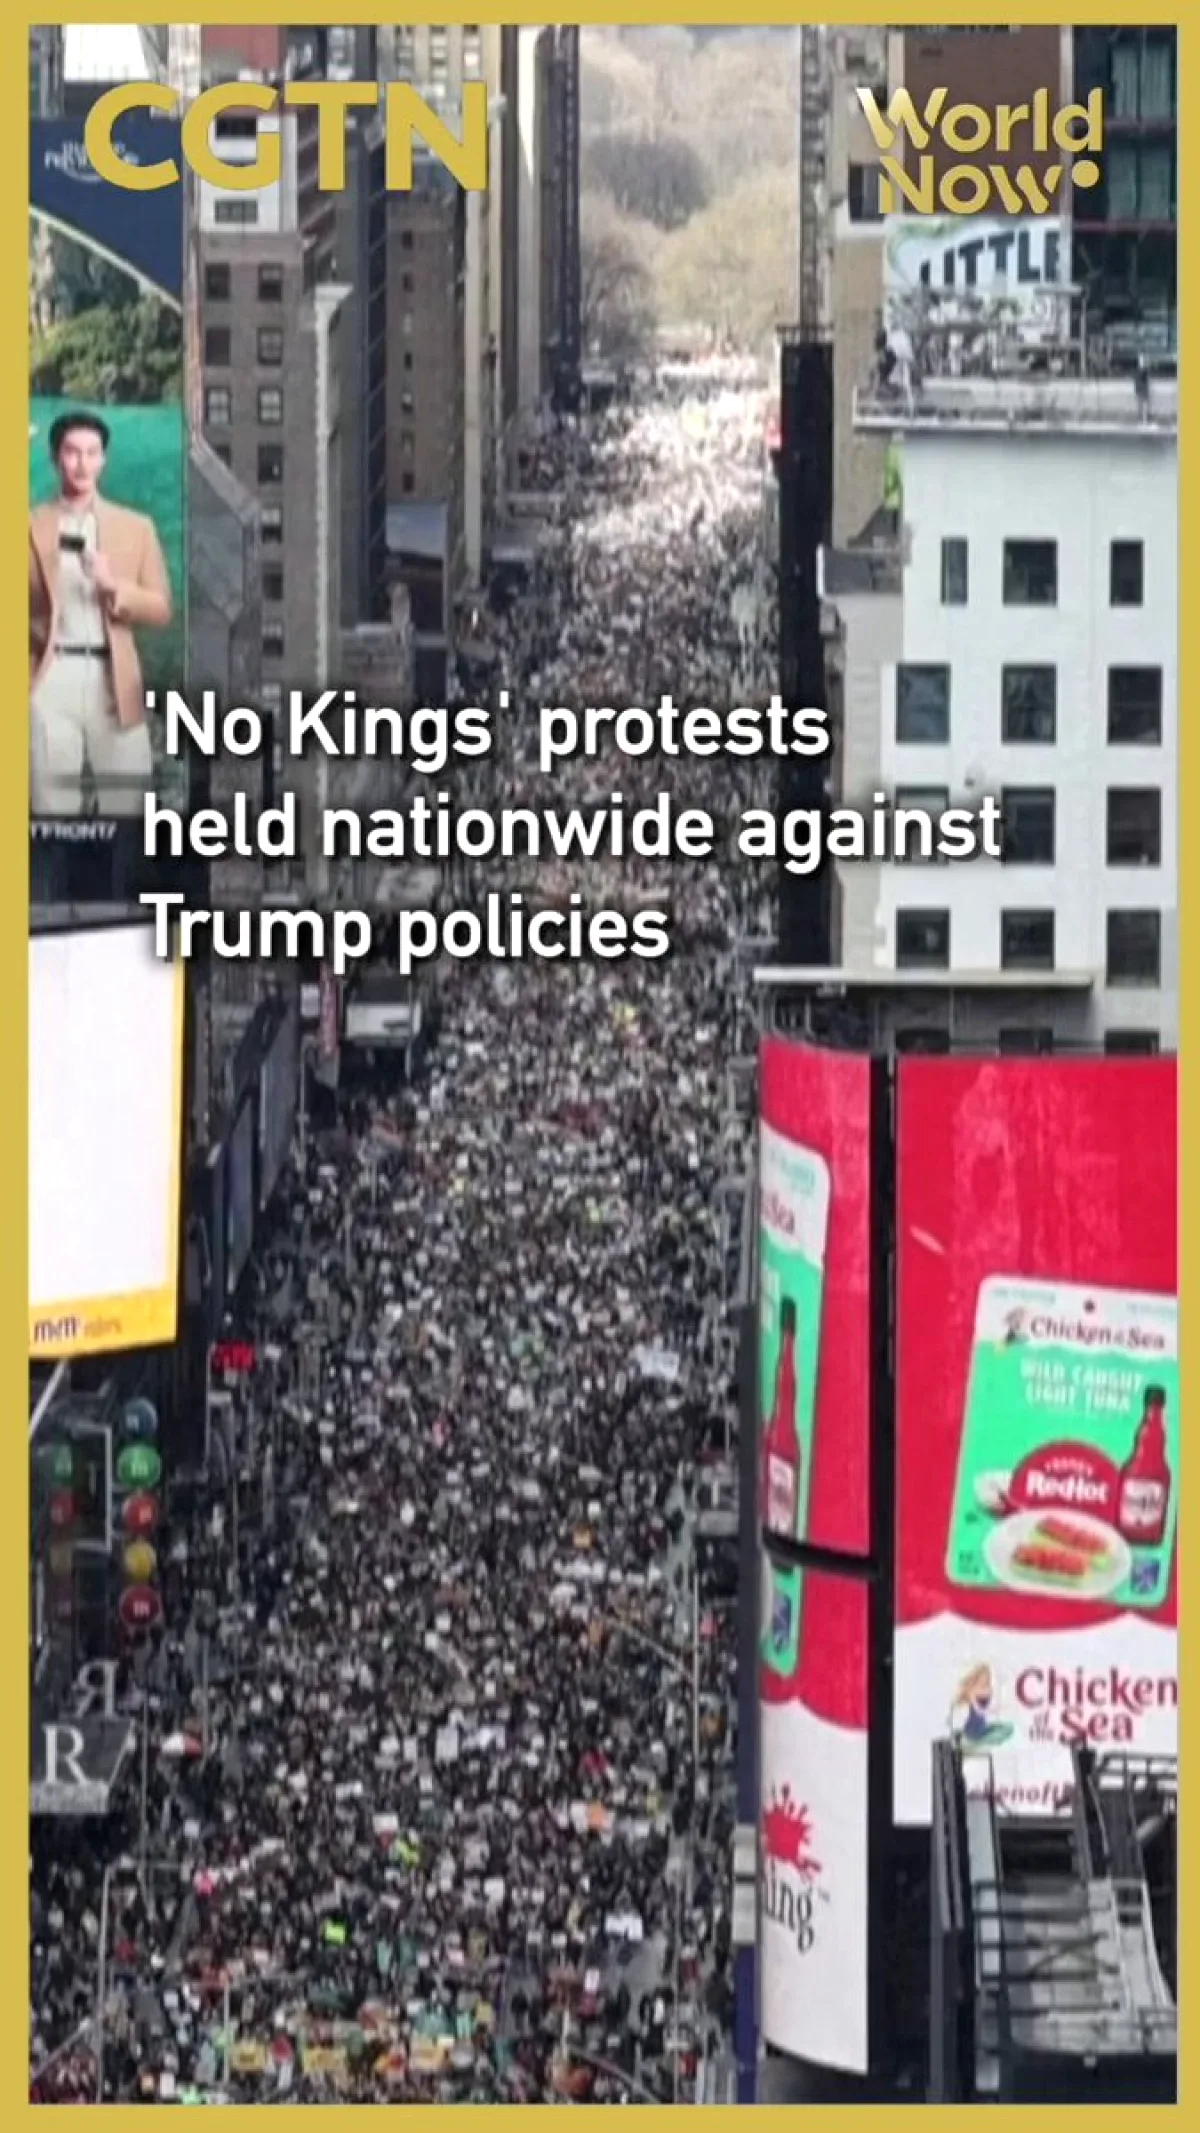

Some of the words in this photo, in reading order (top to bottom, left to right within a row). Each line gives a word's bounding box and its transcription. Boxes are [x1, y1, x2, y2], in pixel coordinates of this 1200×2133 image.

[1030, 1314, 1112, 1346] Chicken
[1126, 1324, 1166, 1350] Sea
[1026, 1469, 1109, 1504] RedHot
[1014, 1665, 1177, 1717] Chicken
[1058, 1708, 1134, 1746] Sea
[41, 1724, 89, 1784] R
